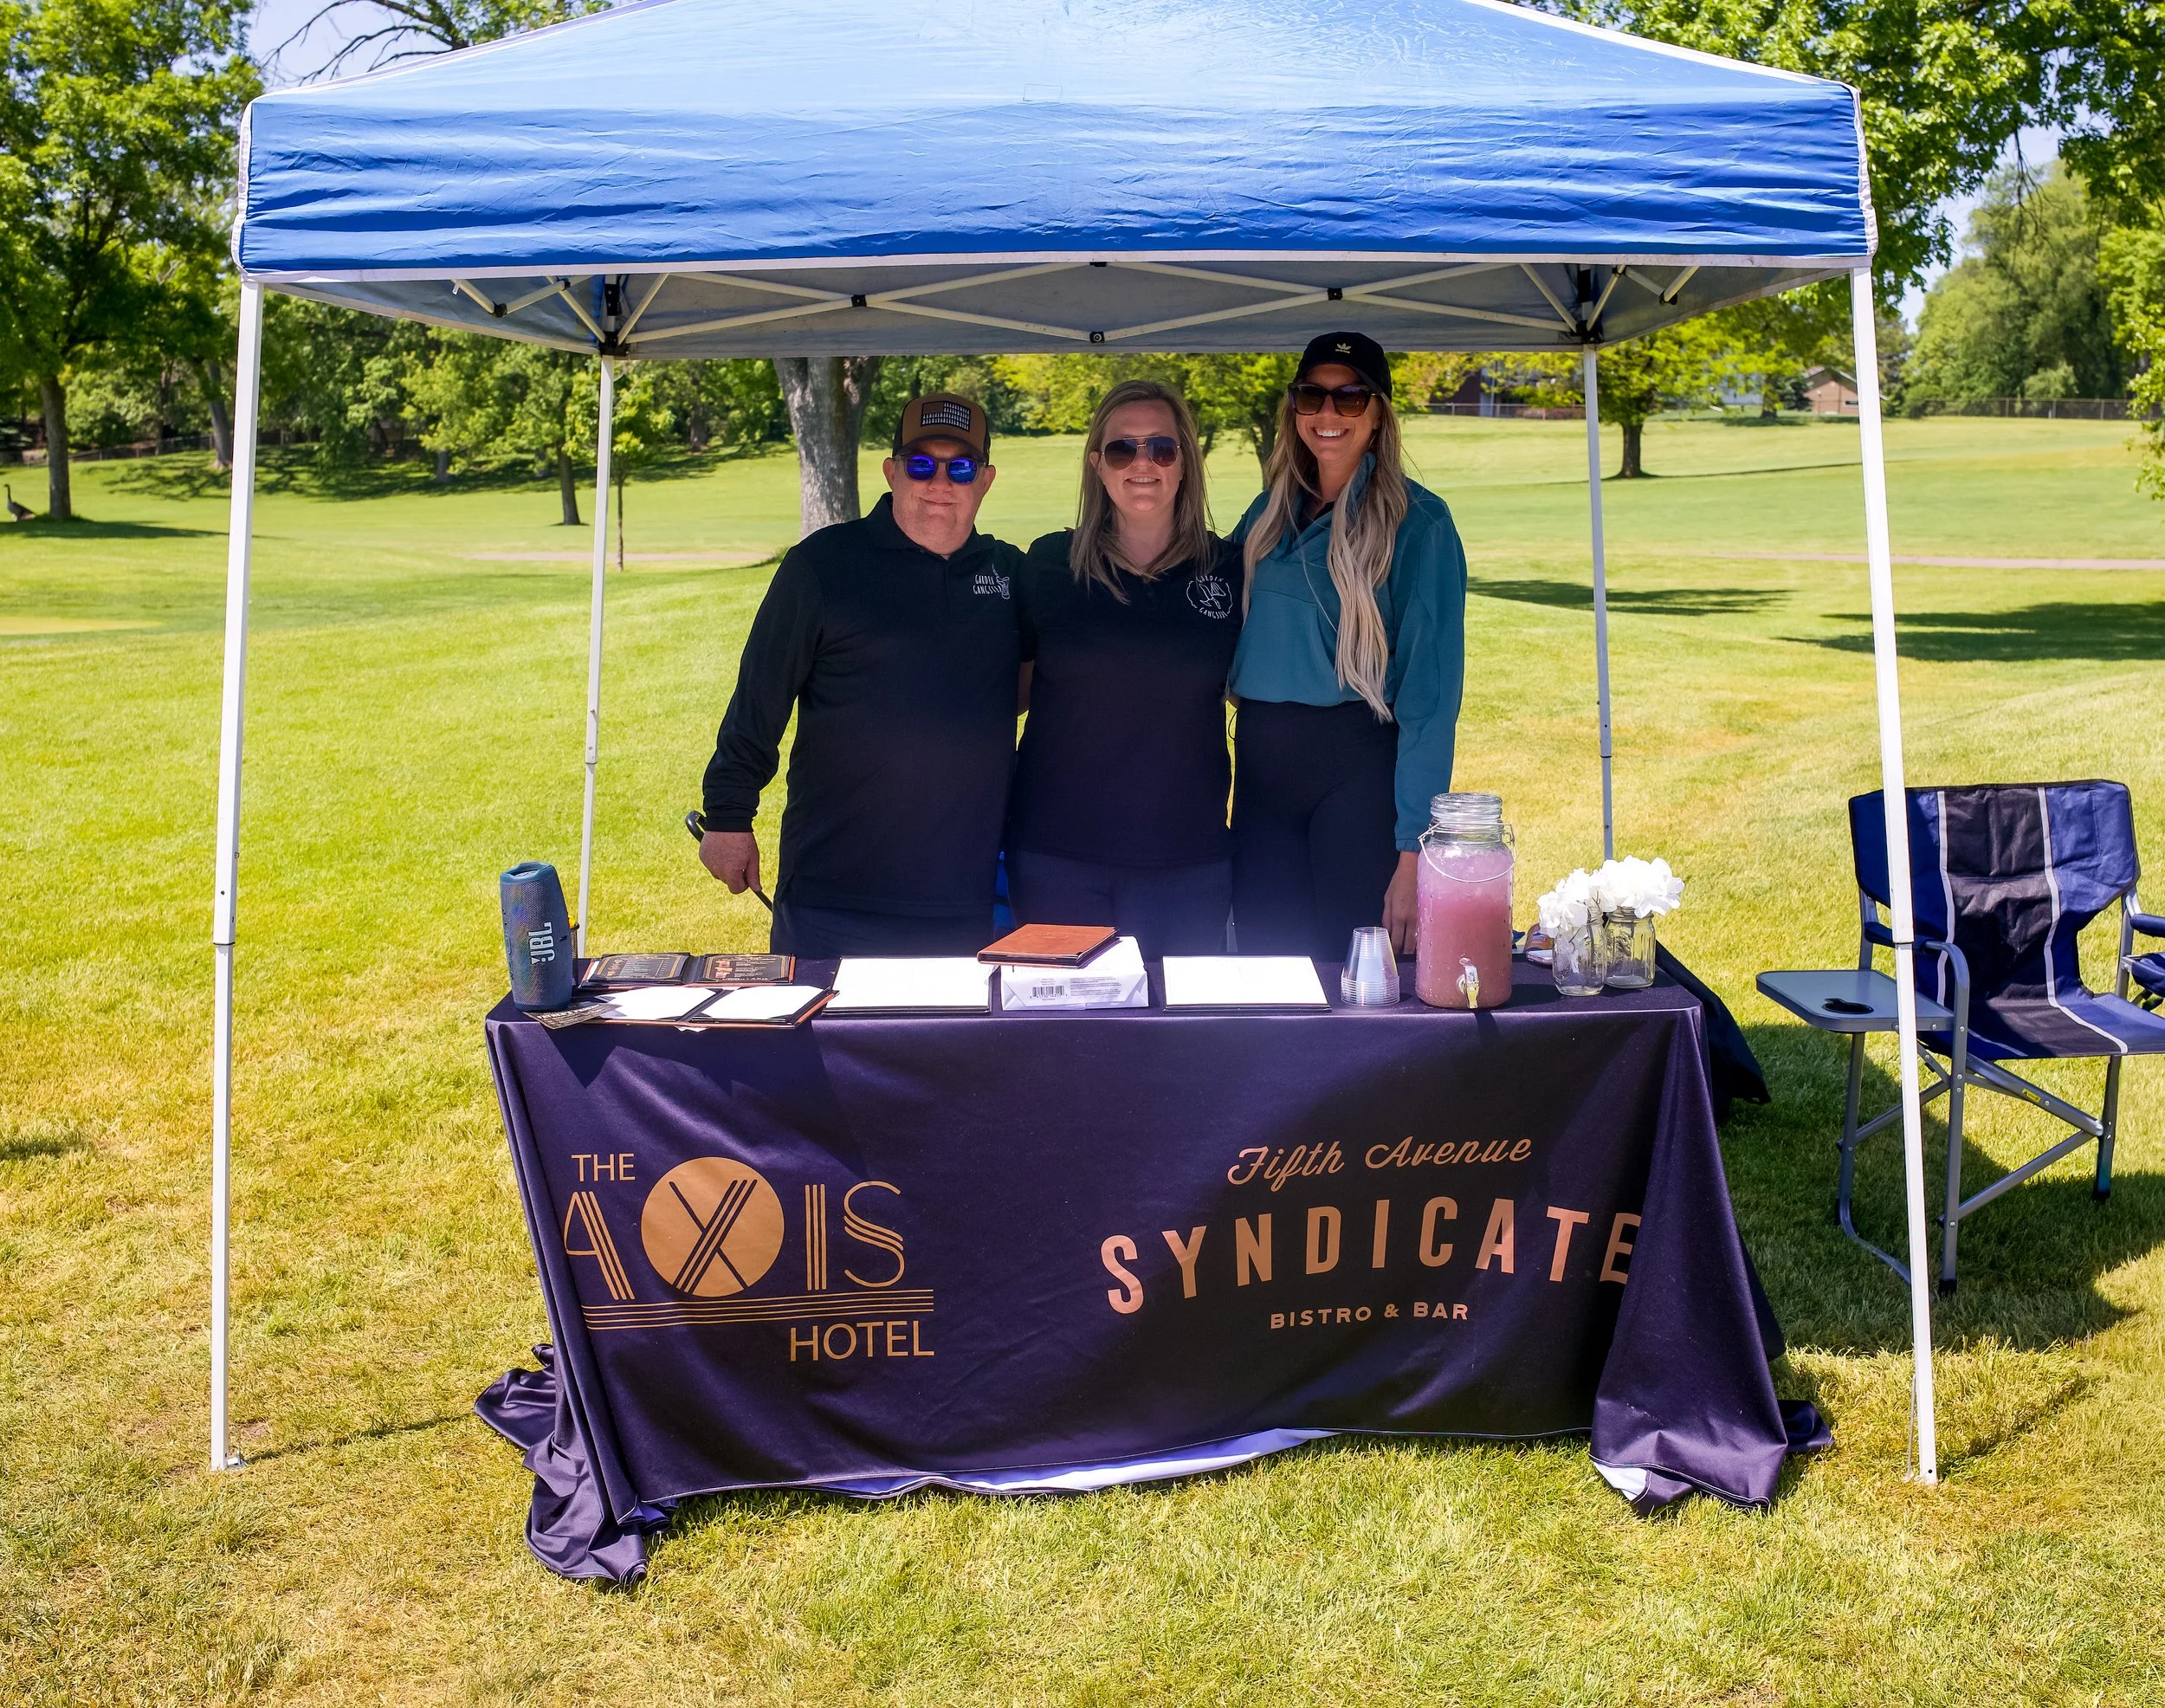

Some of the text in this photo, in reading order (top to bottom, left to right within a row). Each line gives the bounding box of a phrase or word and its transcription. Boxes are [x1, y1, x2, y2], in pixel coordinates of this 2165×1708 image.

[527, 922, 555, 965] JBL
[571, 1153, 636, 1182] THE
[1227, 1135, 1532, 1192] Fifth Avenue
[564, 1178, 904, 1300] AXIS
[1100, 1196, 1642, 1315] SYNDICATE
[1270, 1301, 1469, 1330] BISTRO & BAR
[790, 1320, 934, 1362] HOTEL
